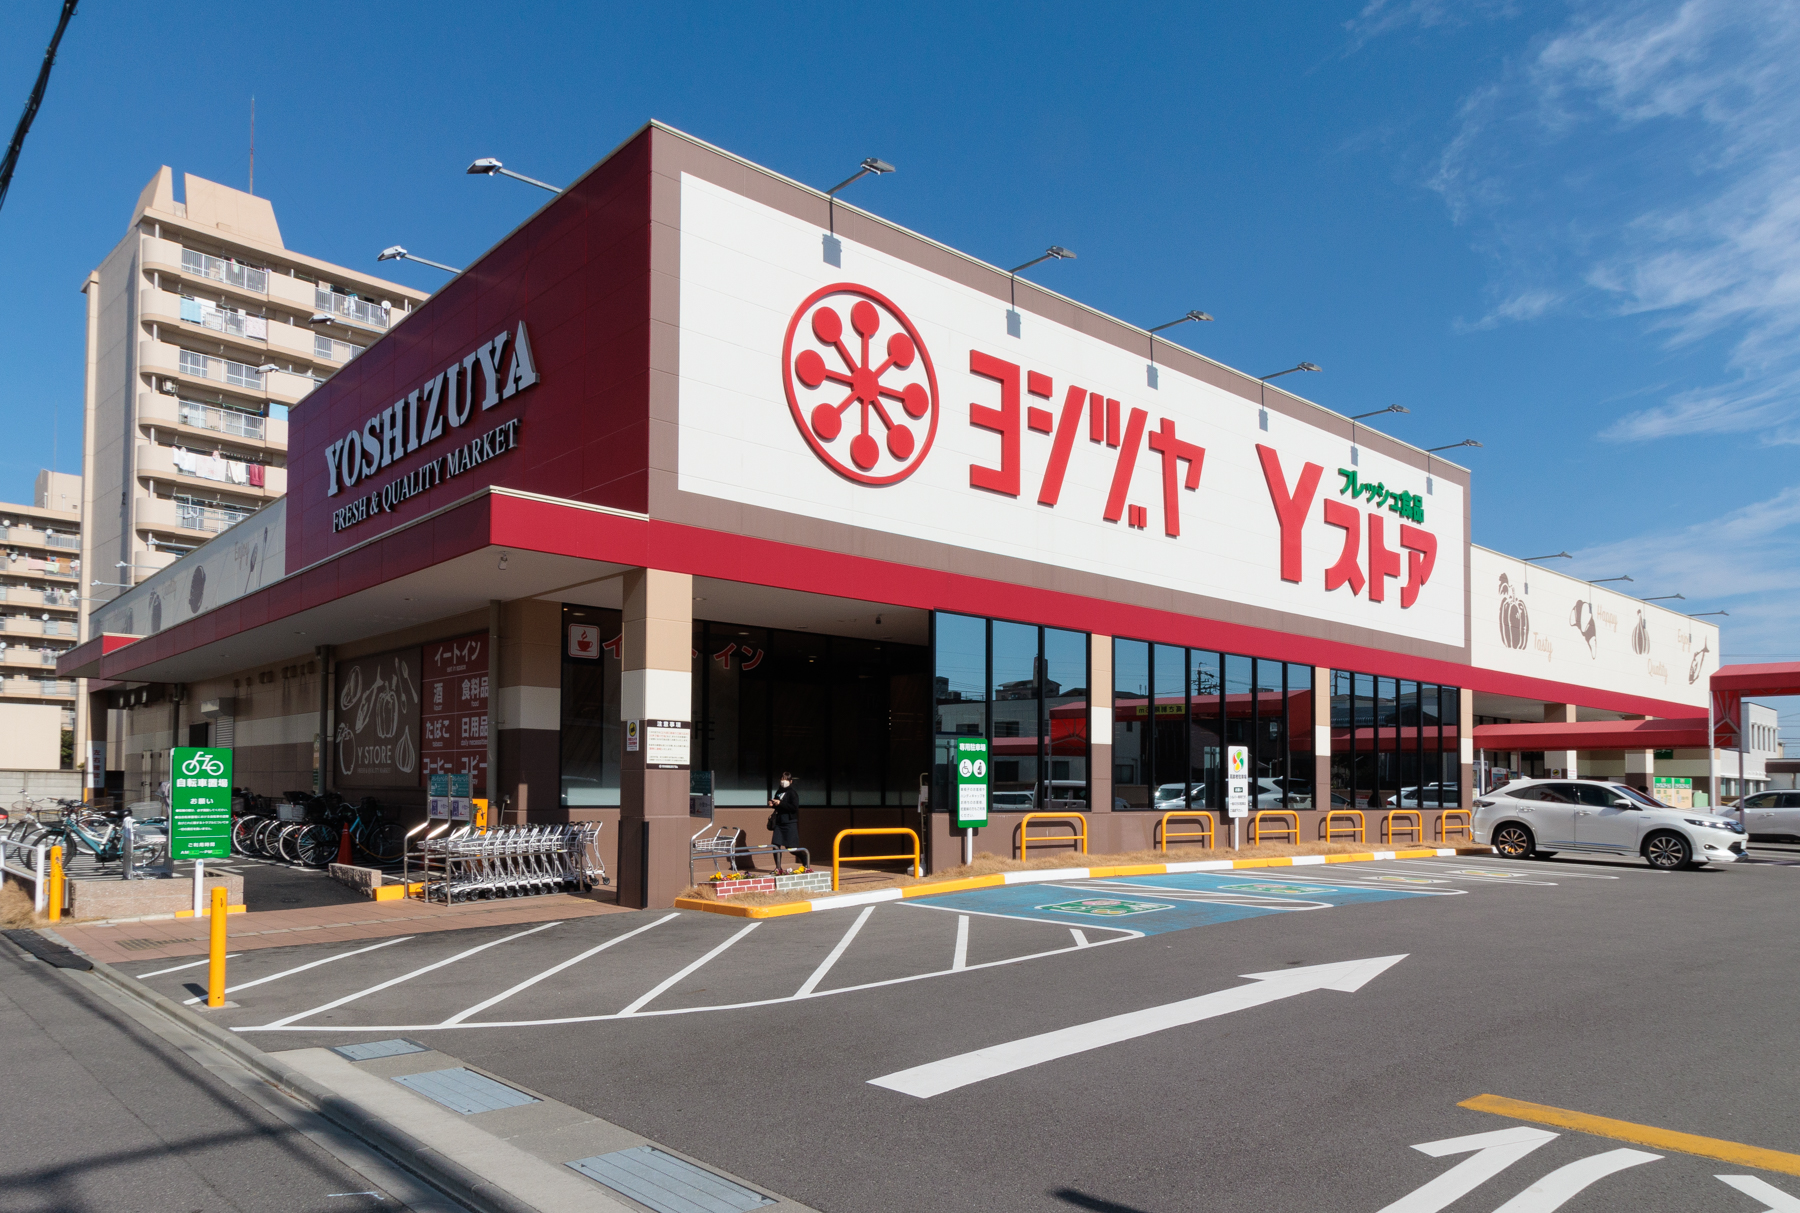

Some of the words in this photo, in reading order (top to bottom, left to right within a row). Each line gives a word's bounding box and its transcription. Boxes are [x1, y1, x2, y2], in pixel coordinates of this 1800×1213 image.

[325, 320, 540, 497] YOSHIZUYA
[969, 349, 1206, 538] ヨシヅヤ
[333, 490, 367, 533] FRESH
[369, 491, 379, 515] &
[382, 457, 442, 512] QUALITY
[446, 418, 522, 478] MARKET
[1338, 467, 1425, 524] フレッシュ食品
[1597, 604, 1618, 633] Happy
[1533, 632, 1553, 663] Tasty
[1677, 628, 1692, 653] Enjoy
[434, 641, 480, 667] イートイン
[1648, 658, 1668, 685] Quality
[434, 683, 443, 704] 酒
[462, 677, 488, 700] 食料品
[426, 719, 449, 739] たばこ
[462, 716, 488, 737] 日用品
[358, 746, 363, 764] Y
[364, 745, 392, 764] STORE
[959, 743, 986, 752] 専用駐車場
[423, 757, 452, 774] コーヒー
[461, 755, 488, 774] コピー
[176, 778, 228, 787] 自転車置場
